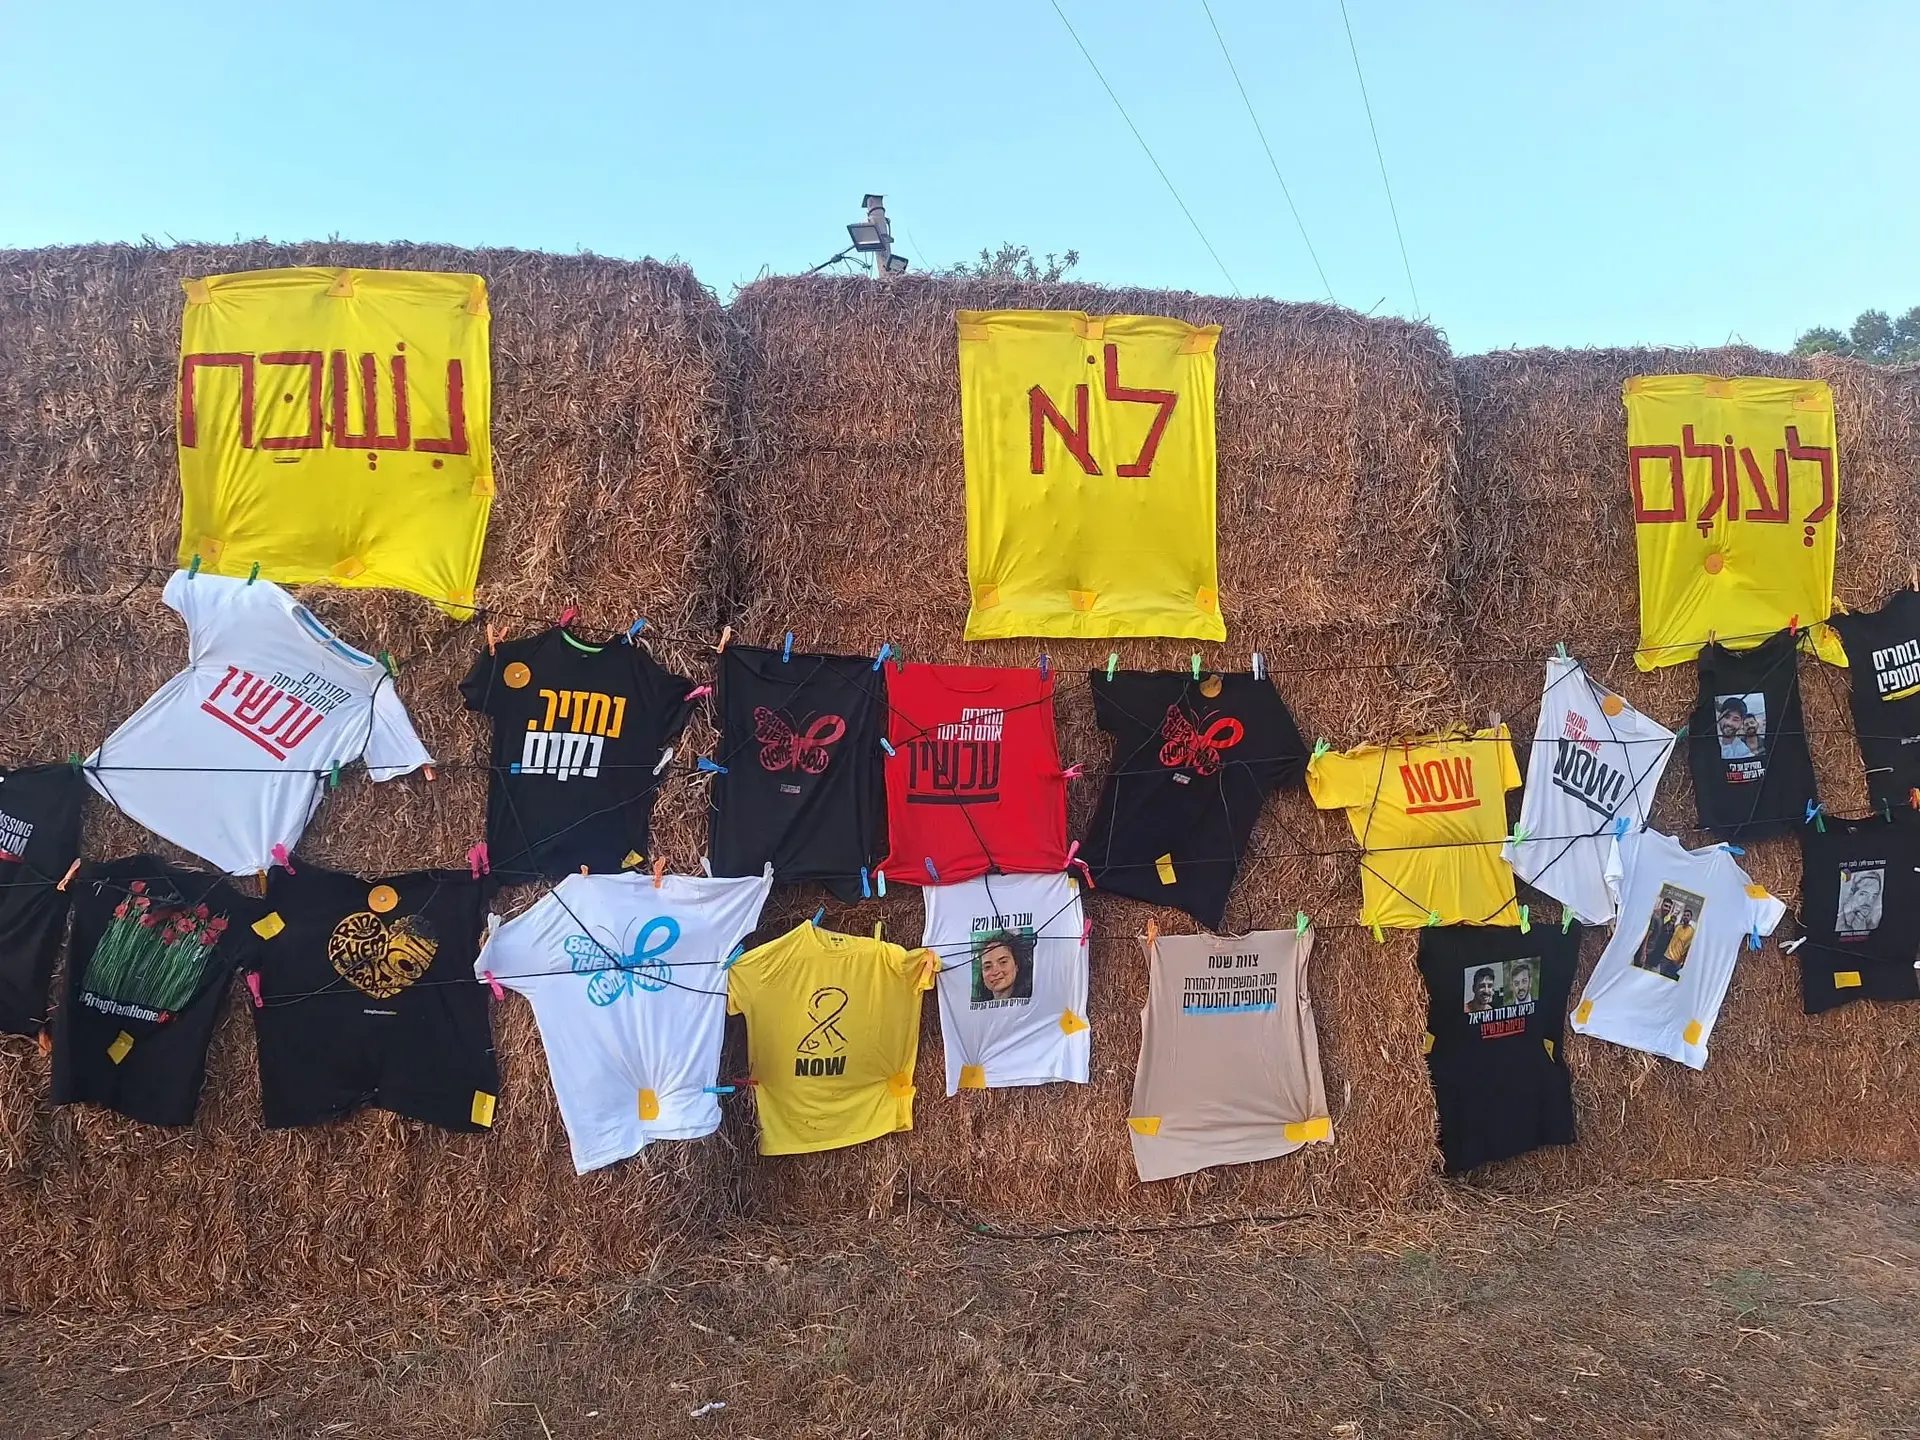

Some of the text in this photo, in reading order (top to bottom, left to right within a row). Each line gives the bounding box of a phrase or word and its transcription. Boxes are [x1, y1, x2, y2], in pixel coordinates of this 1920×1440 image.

[302, 672, 352, 704] מחזירים
[208, 665, 325, 749] עכשיו
[304, 692, 338, 716] אותם
[937, 723, 1003, 741] אותם הביתה
[1566, 709, 1589, 733] BRING
[520, 731, 605, 782] נקום
[907, 741, 1001, 789] עכשיו
[1399, 756, 1474, 804] NOW
[1553, 737, 1625, 811] NOW!
[0, 811, 34, 837] ISSING
[1013, 913, 1033, 927] ענבר
[1208, 953, 1259, 969] צוות שטח
[1217, 974, 1258, 990] המשפחות
[1260, 972, 1277, 986] מטה
[1183, 987, 1277, 1009] החטופים והנעדרים
[795, 1056, 847, 1076] NOW
